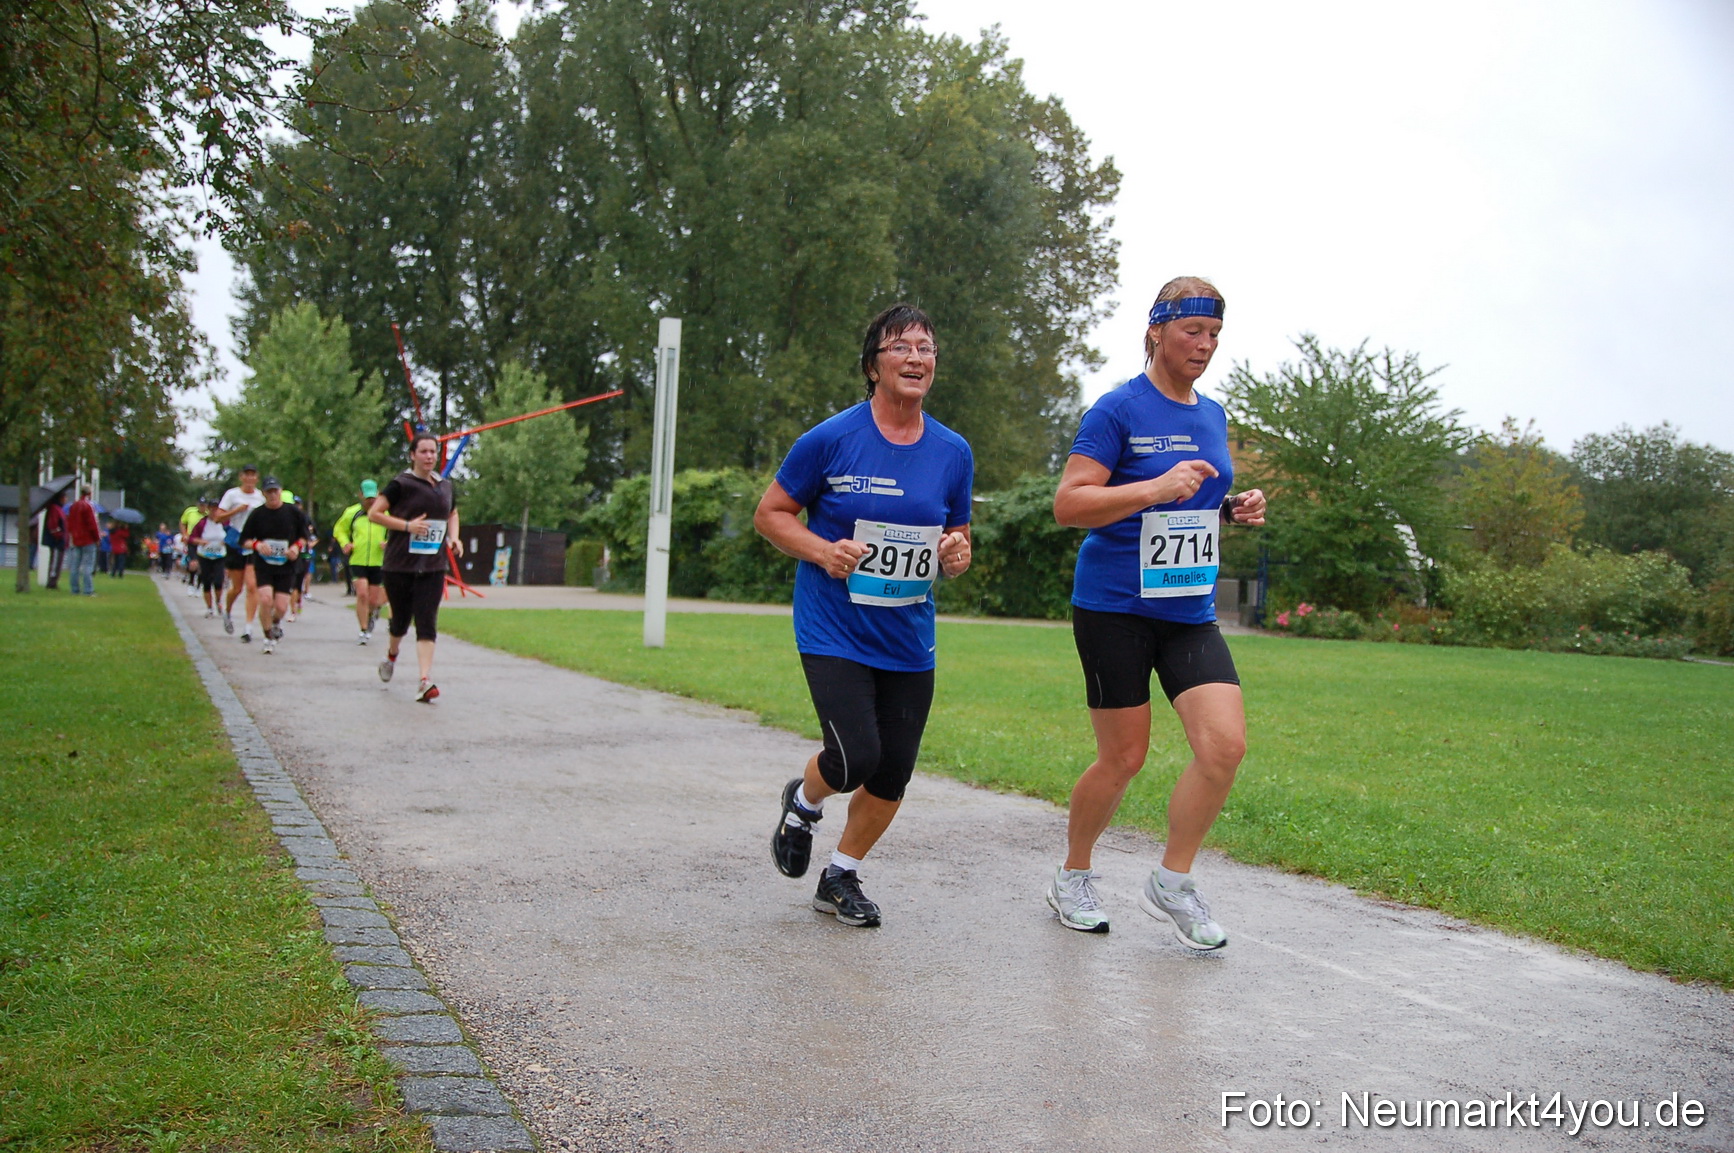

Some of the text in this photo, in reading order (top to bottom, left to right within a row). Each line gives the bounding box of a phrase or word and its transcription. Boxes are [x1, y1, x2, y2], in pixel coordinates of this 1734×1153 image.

[858, 543, 932, 578] 2918
[1150, 533, 1213, 566] 2714
[883, 583, 901, 596] Evi
[1162, 572, 1208, 585] Annelies
